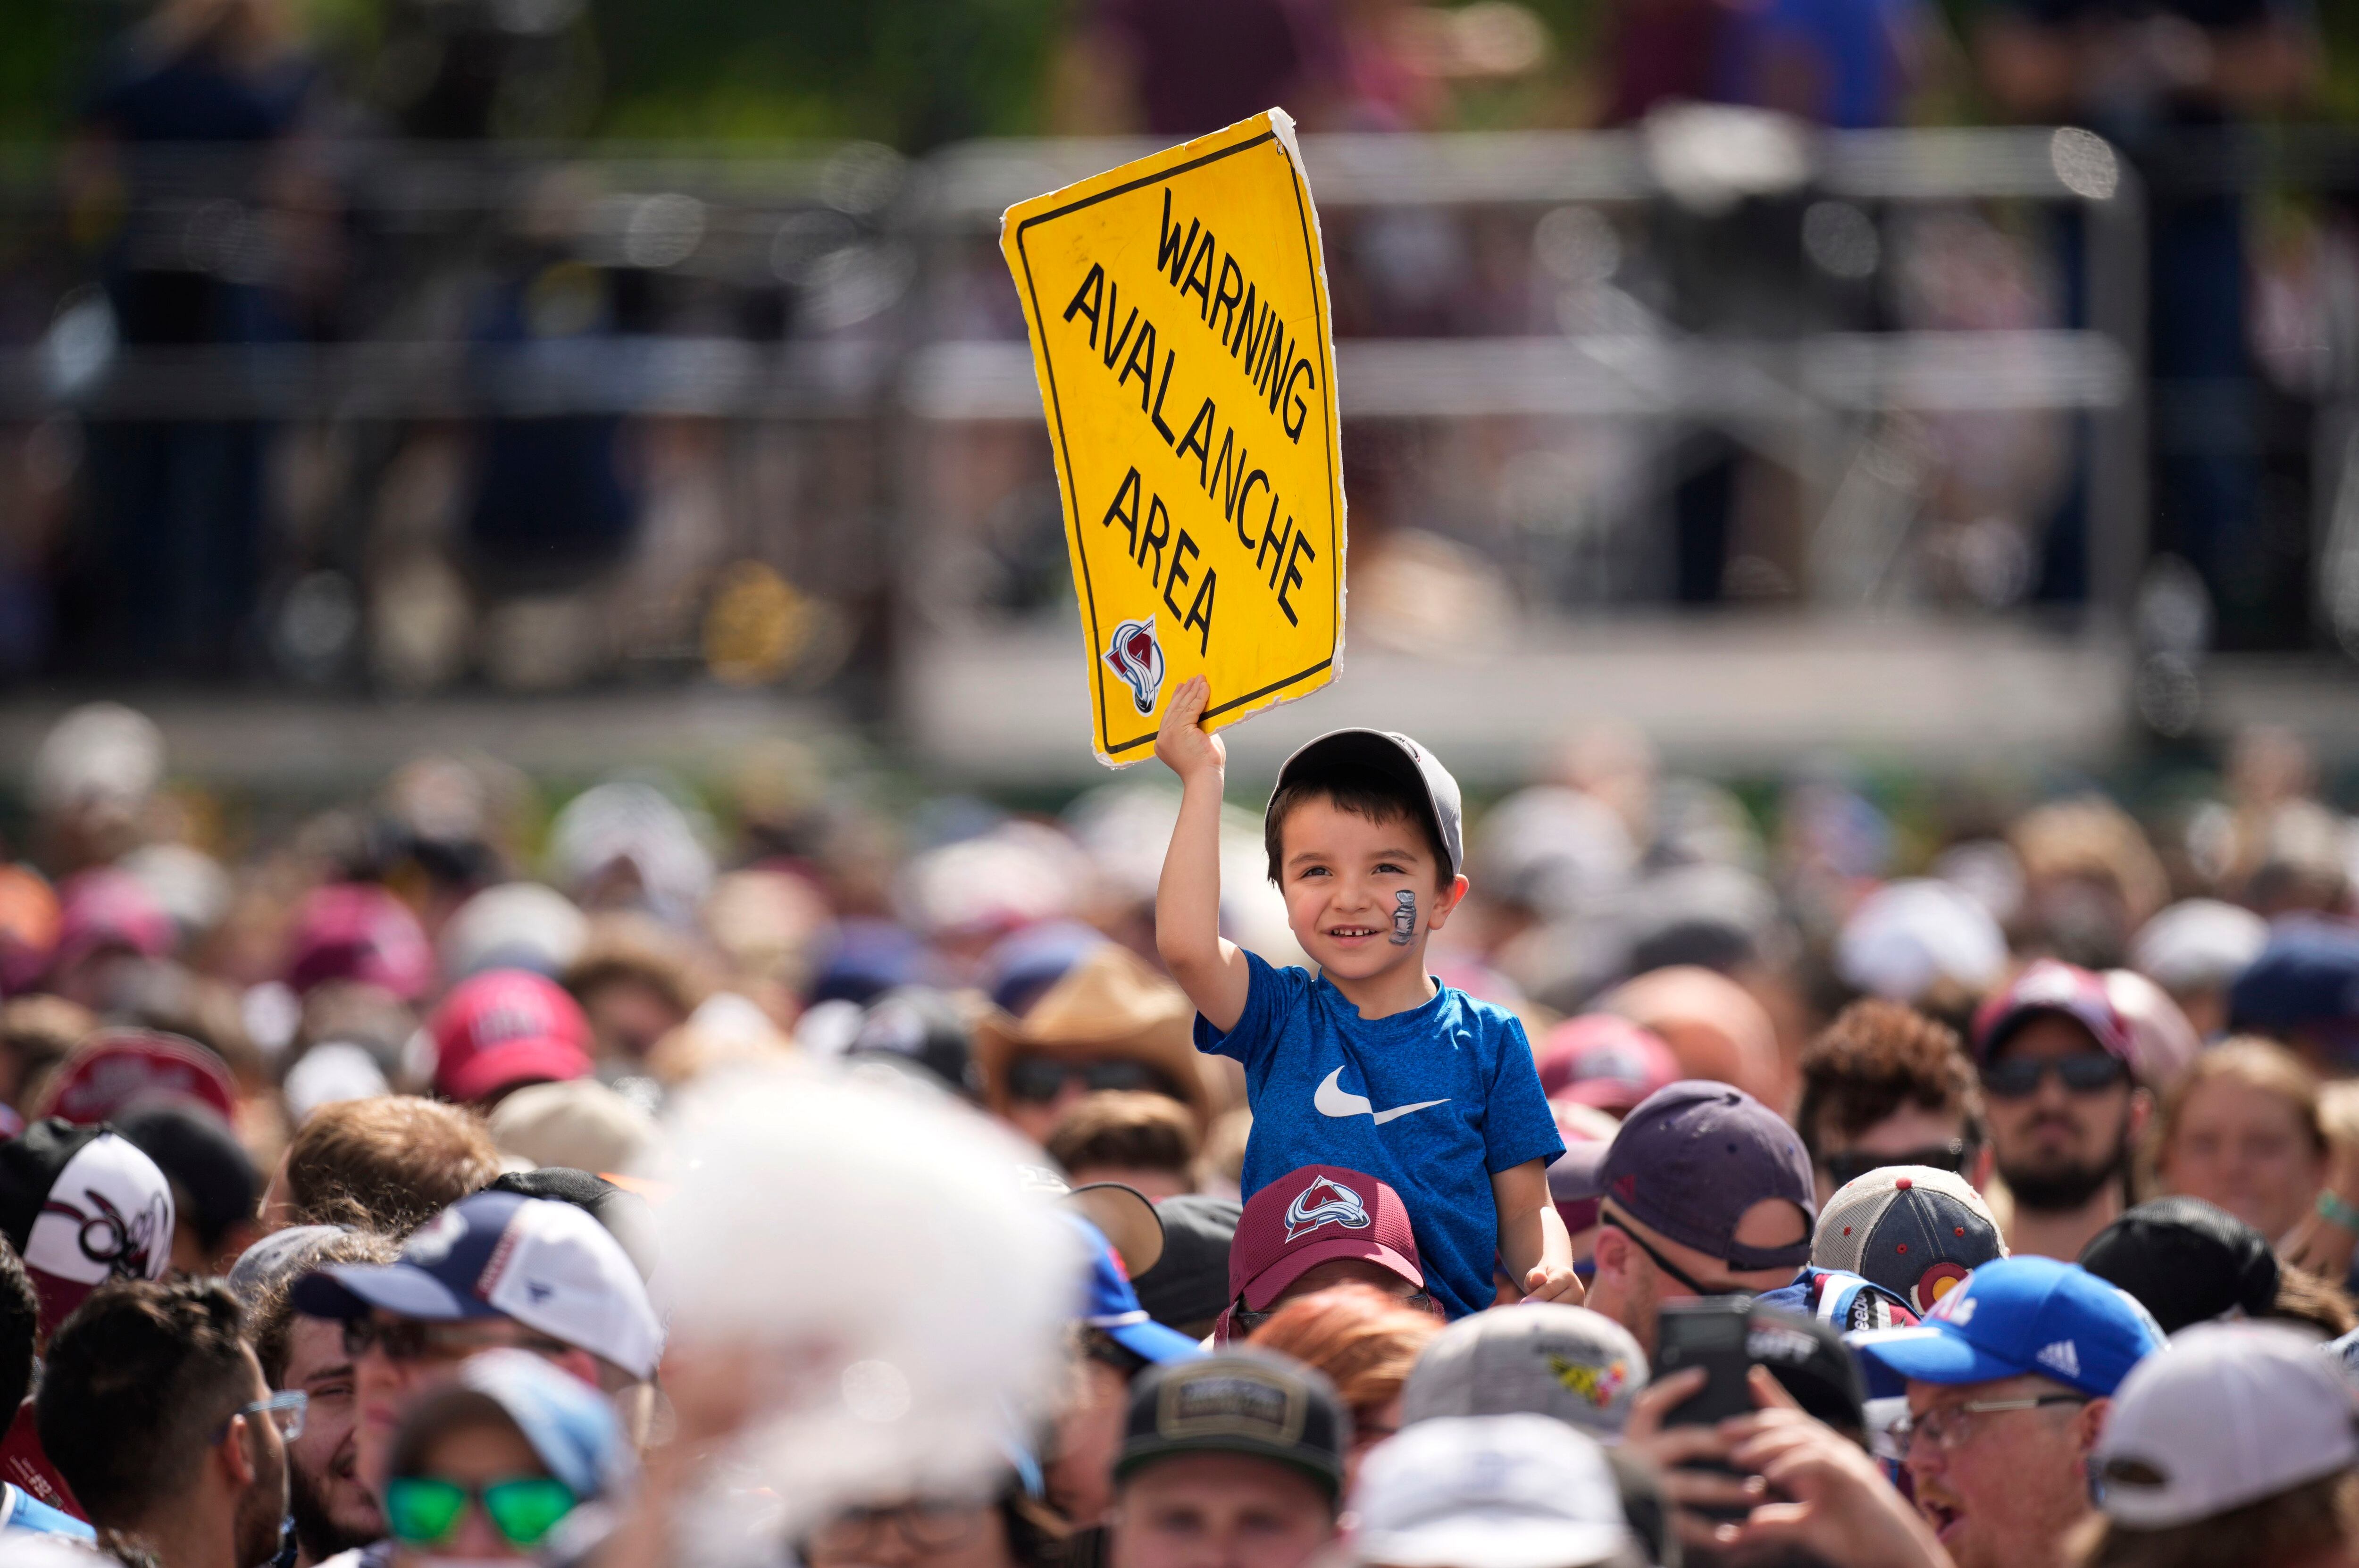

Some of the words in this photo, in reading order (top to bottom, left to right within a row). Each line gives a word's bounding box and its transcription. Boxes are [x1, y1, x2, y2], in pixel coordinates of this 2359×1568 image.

[1063, 263, 1315, 627] AVALANCHE
[1157, 187, 1315, 445] WARNING
[1103, 466, 1217, 657] AREA
